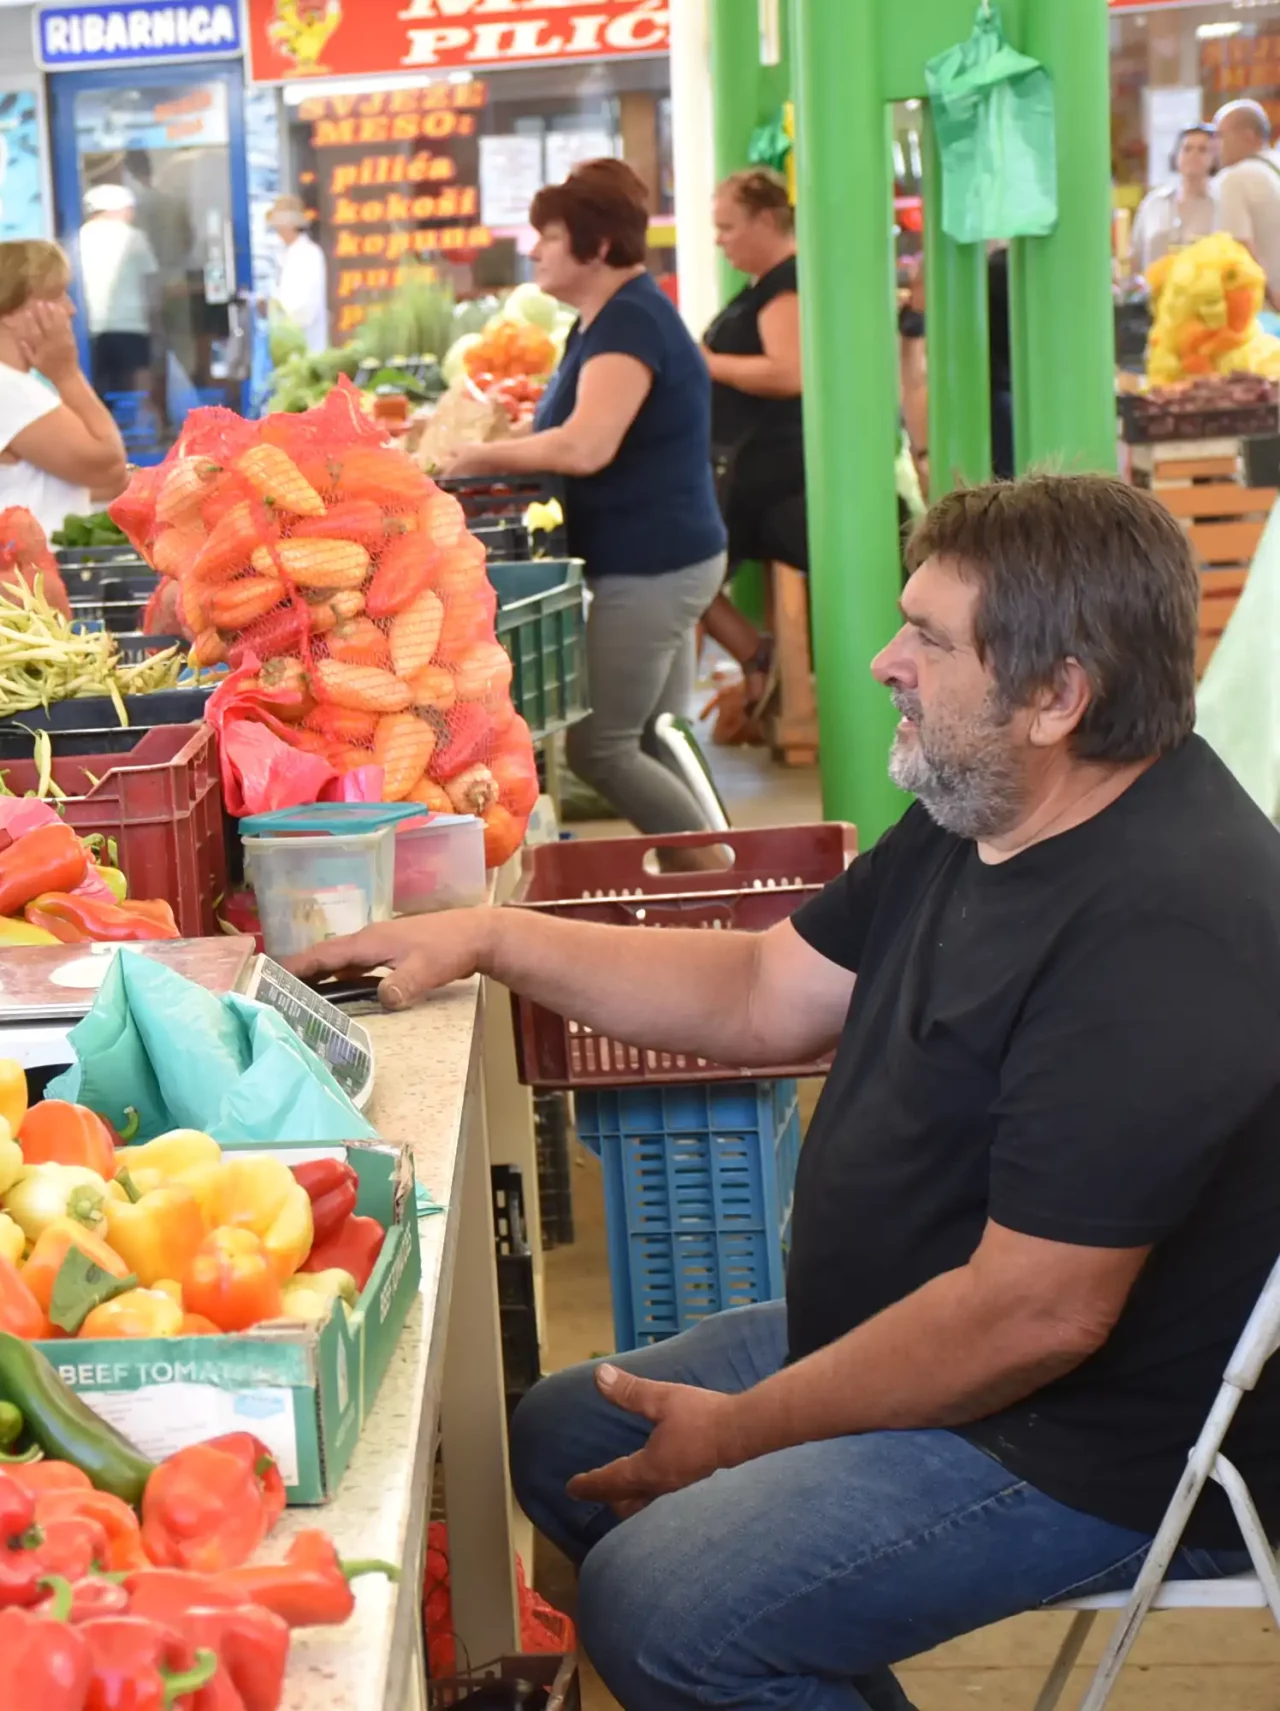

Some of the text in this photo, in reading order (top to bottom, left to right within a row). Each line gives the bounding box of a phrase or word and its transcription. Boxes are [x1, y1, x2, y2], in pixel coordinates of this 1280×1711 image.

[45, 5, 235, 55] RIBARNICA
[400, 0, 669, 65] PILIĆ
[330, 150, 454, 194] pilića
[58, 1362, 128, 1385] BEEF
